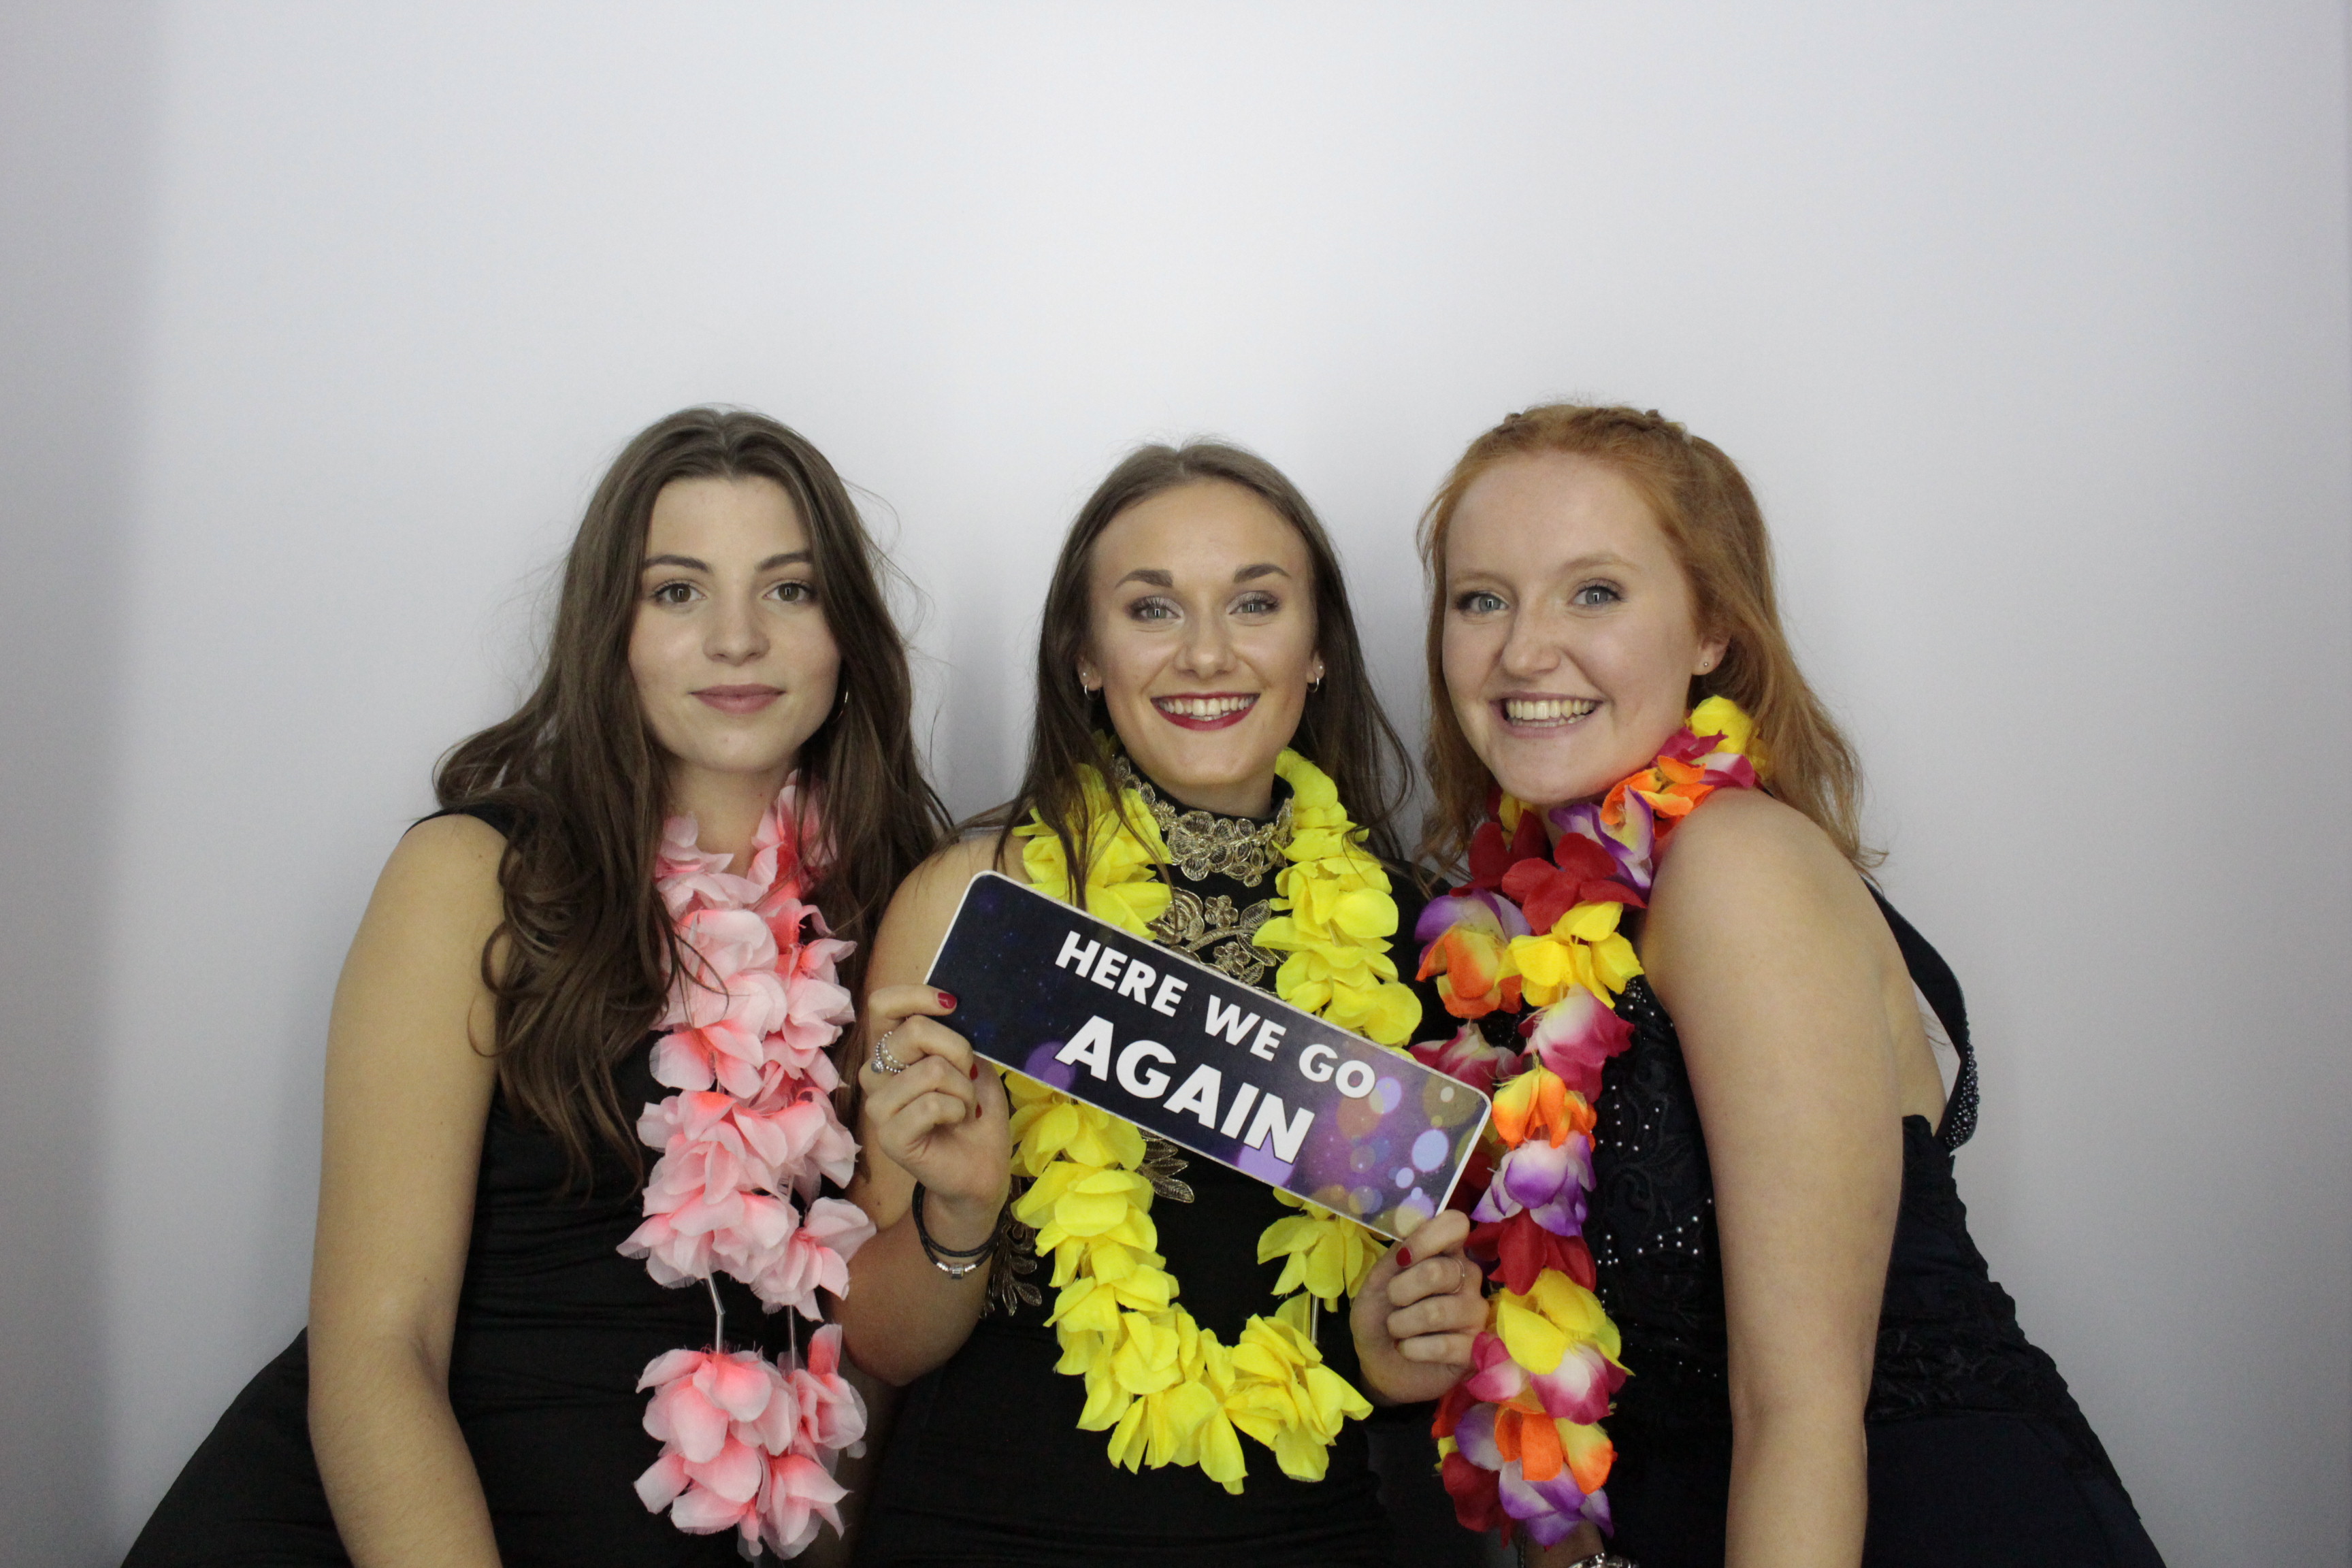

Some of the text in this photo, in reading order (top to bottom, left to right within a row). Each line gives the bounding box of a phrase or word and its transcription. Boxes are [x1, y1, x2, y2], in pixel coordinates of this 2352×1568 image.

[1054, 1015, 1316, 1164] AGAIN
[1055, 930, 1375, 1098] HERE WE GO
